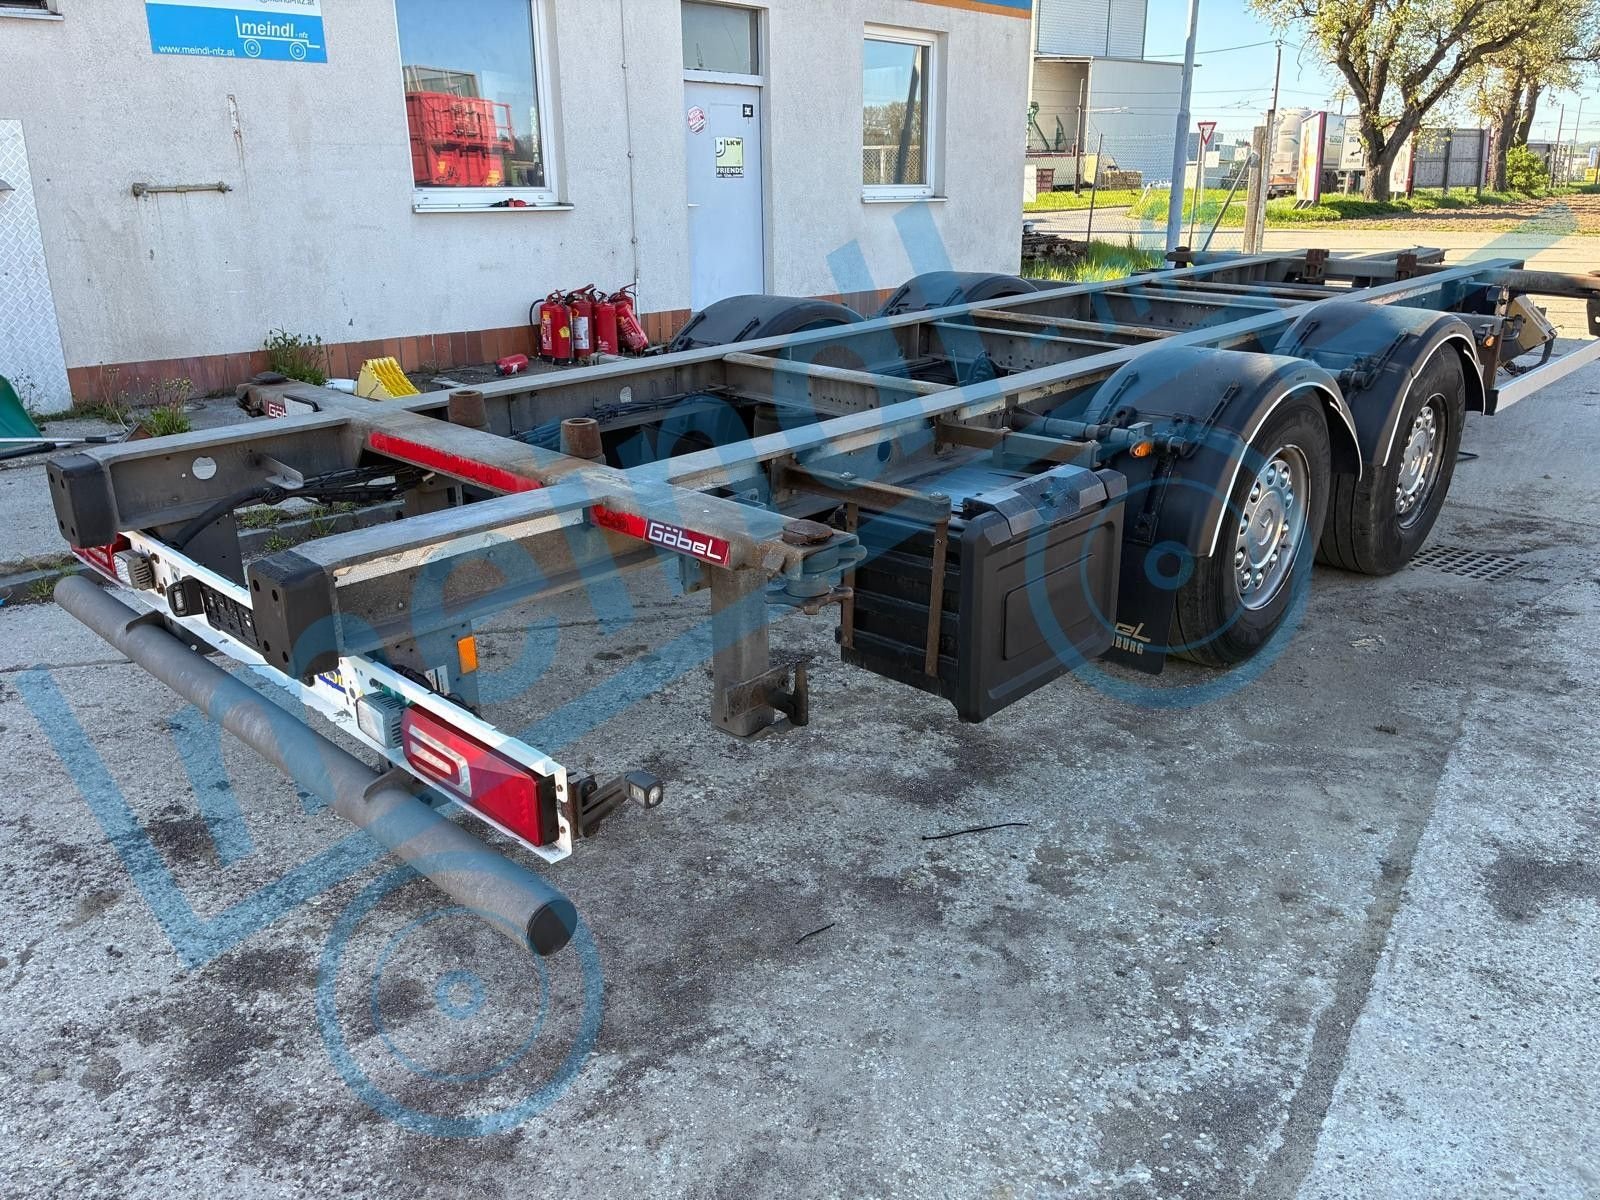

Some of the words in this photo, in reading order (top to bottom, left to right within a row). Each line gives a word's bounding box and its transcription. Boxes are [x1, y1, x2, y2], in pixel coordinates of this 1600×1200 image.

[242, 21, 294, 38] meindl
[158, 44, 236, 57] www.meindl-nfz.at
[1112, 634, 1144, 655] BURG
